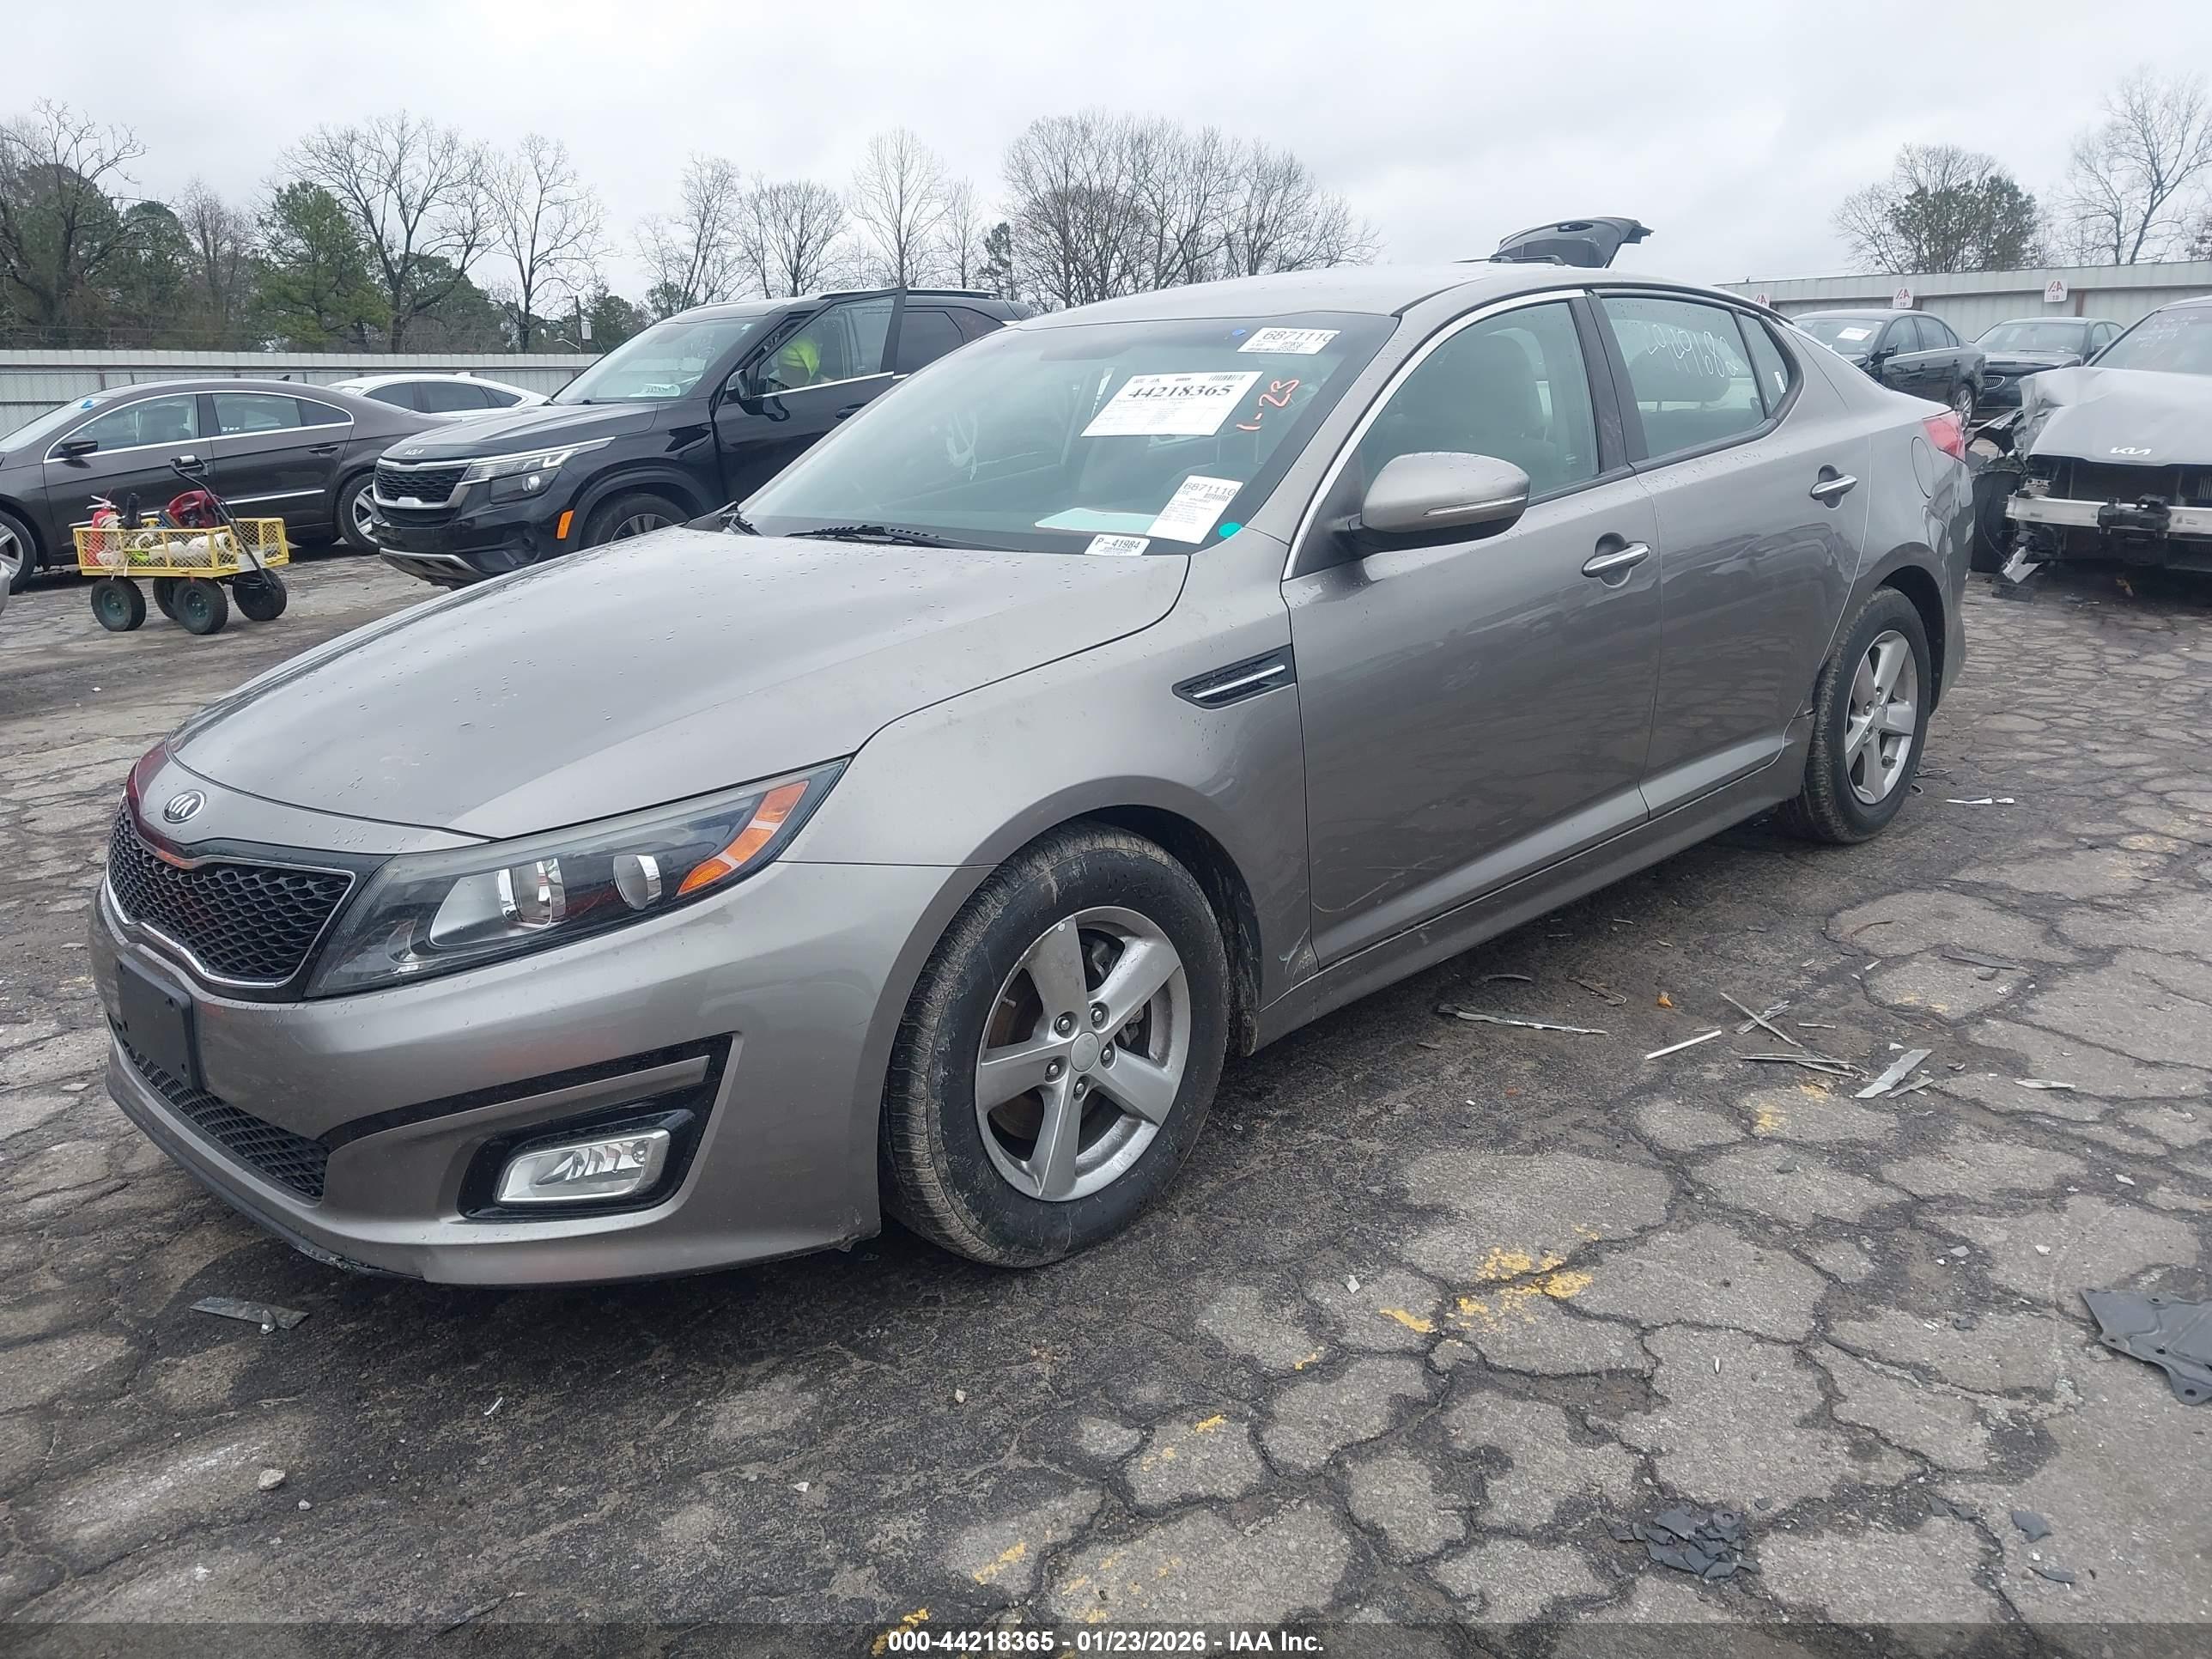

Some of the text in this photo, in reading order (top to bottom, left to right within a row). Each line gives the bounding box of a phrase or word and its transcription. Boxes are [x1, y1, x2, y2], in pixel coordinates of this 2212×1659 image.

[1262, 330, 1339, 343] 6871110
[1127, 385, 1235, 398] 44218365
[1236, 379, 1300, 431] 1-23
[1183, 482, 1237, 496] 6871110
